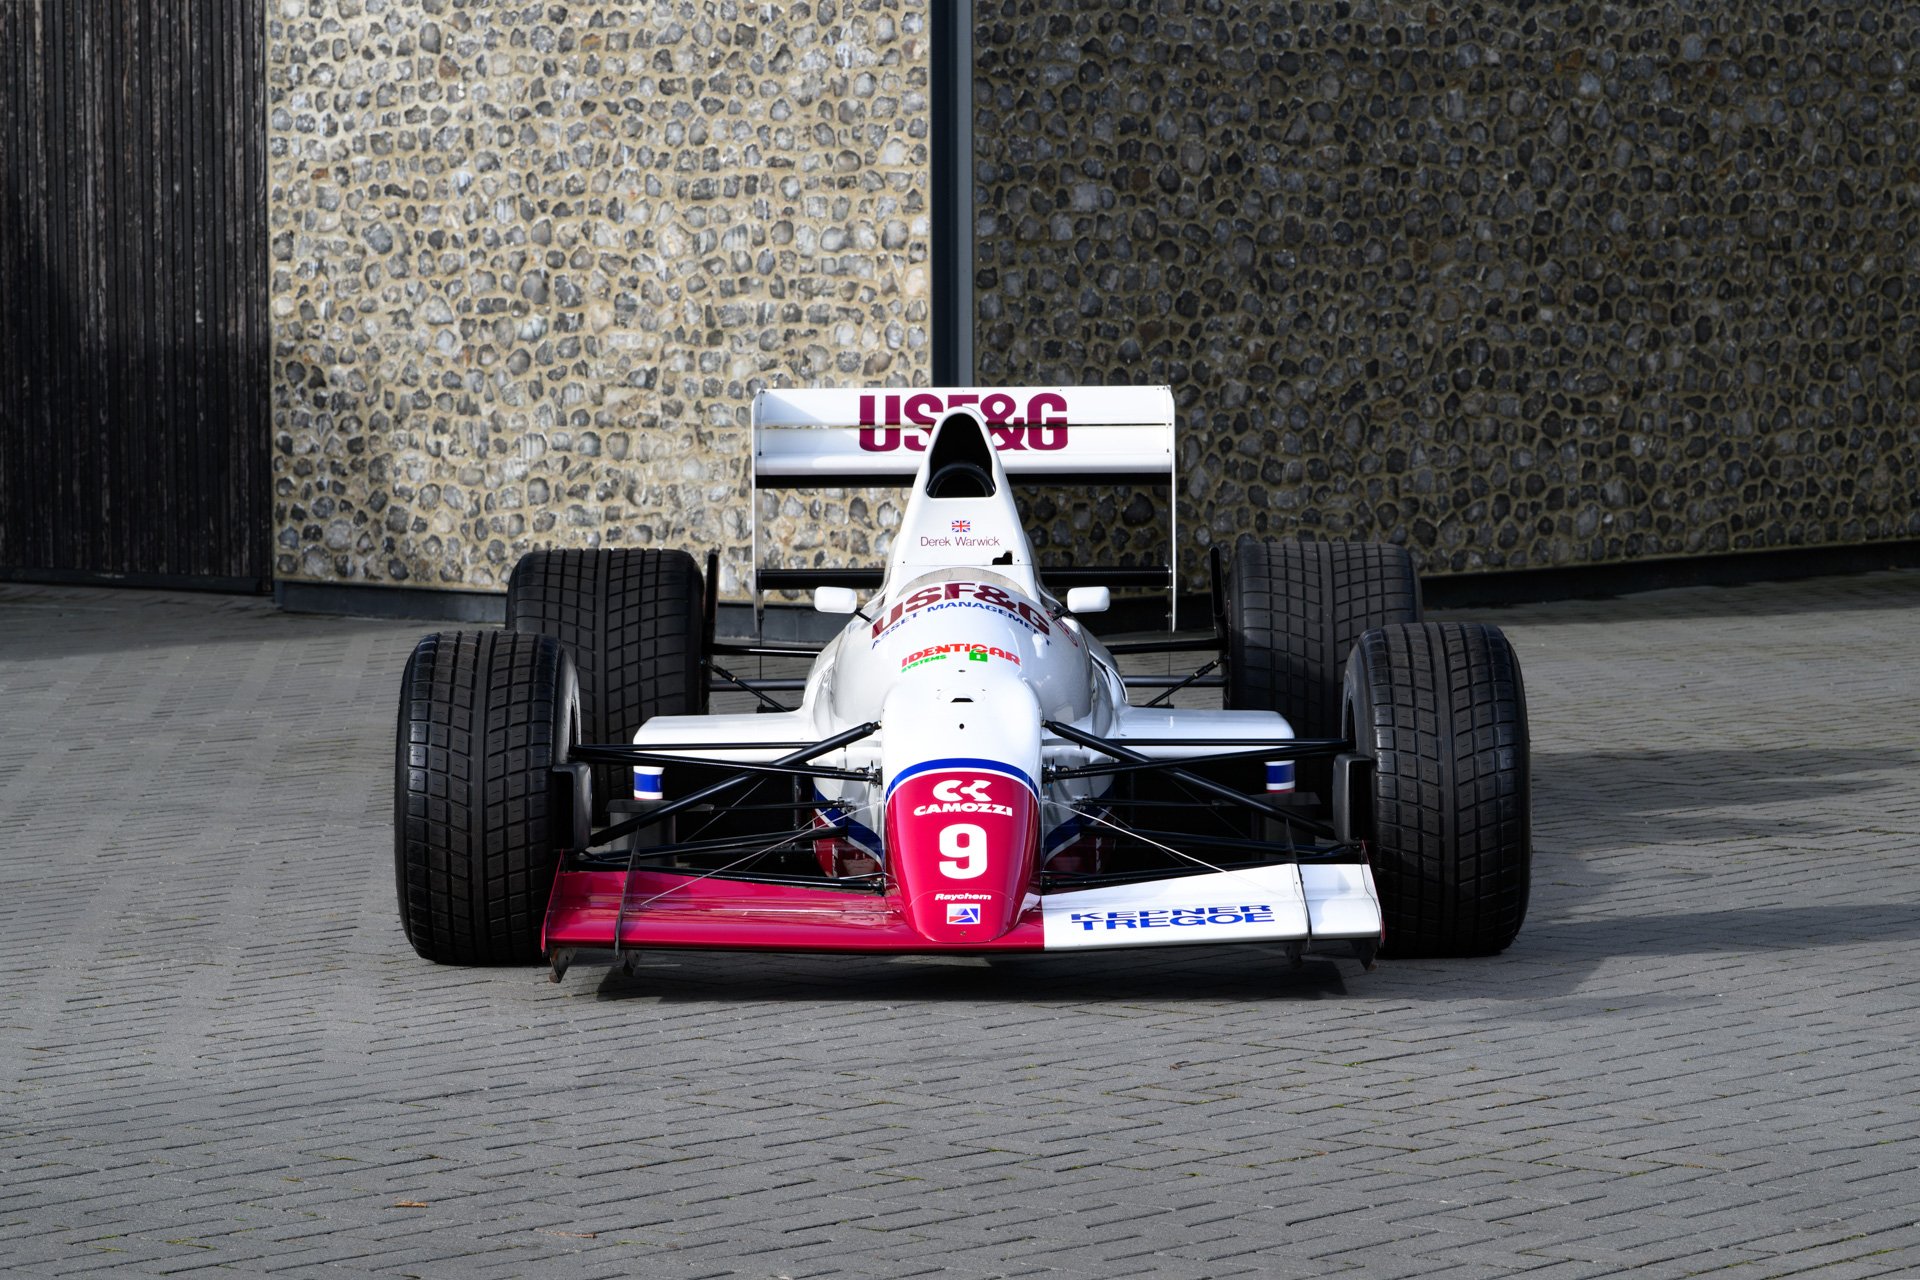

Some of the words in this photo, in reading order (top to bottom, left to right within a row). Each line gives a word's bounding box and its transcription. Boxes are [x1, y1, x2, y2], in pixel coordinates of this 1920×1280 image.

[920, 536, 951, 547] Derek
[955, 536, 1000, 547] Warwick
[872, 583, 1050, 639] USF&G
[901, 643, 1021, 667] IDENTICAR
[901, 654, 947, 673] SYSTEMS
[913, 802, 1013, 817] CAMOZZI
[939, 823, 988, 879] 9
[935, 893, 992, 901] Raychem
[1071, 905, 1271, 920] KEPNER
[1071, 912, 1275, 930] TREGOE
